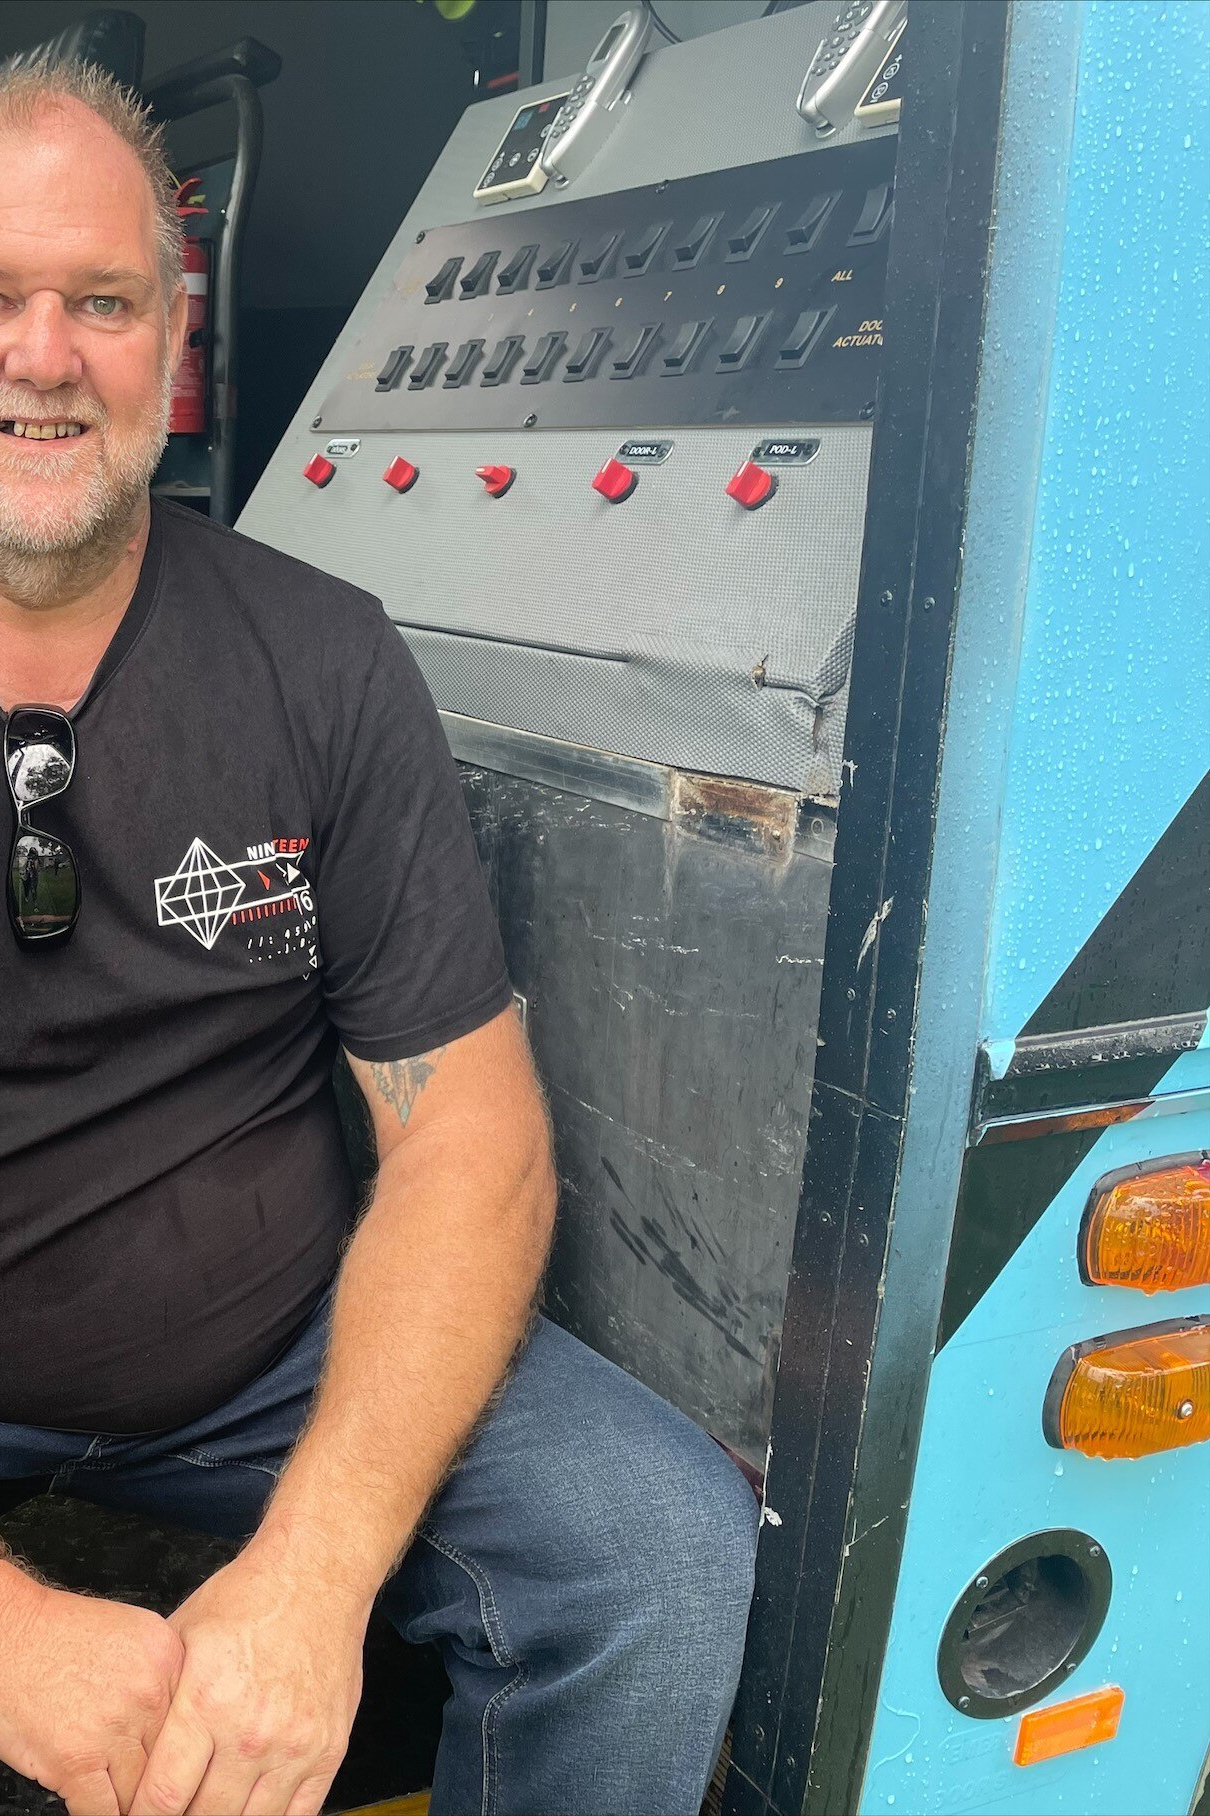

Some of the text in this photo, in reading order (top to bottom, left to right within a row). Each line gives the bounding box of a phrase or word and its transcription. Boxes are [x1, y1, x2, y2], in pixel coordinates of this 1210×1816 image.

[831, 270, 853, 282] ALL
[628, 446, 657, 456] DOOR-L
[769, 445, 797, 454] POD-L
